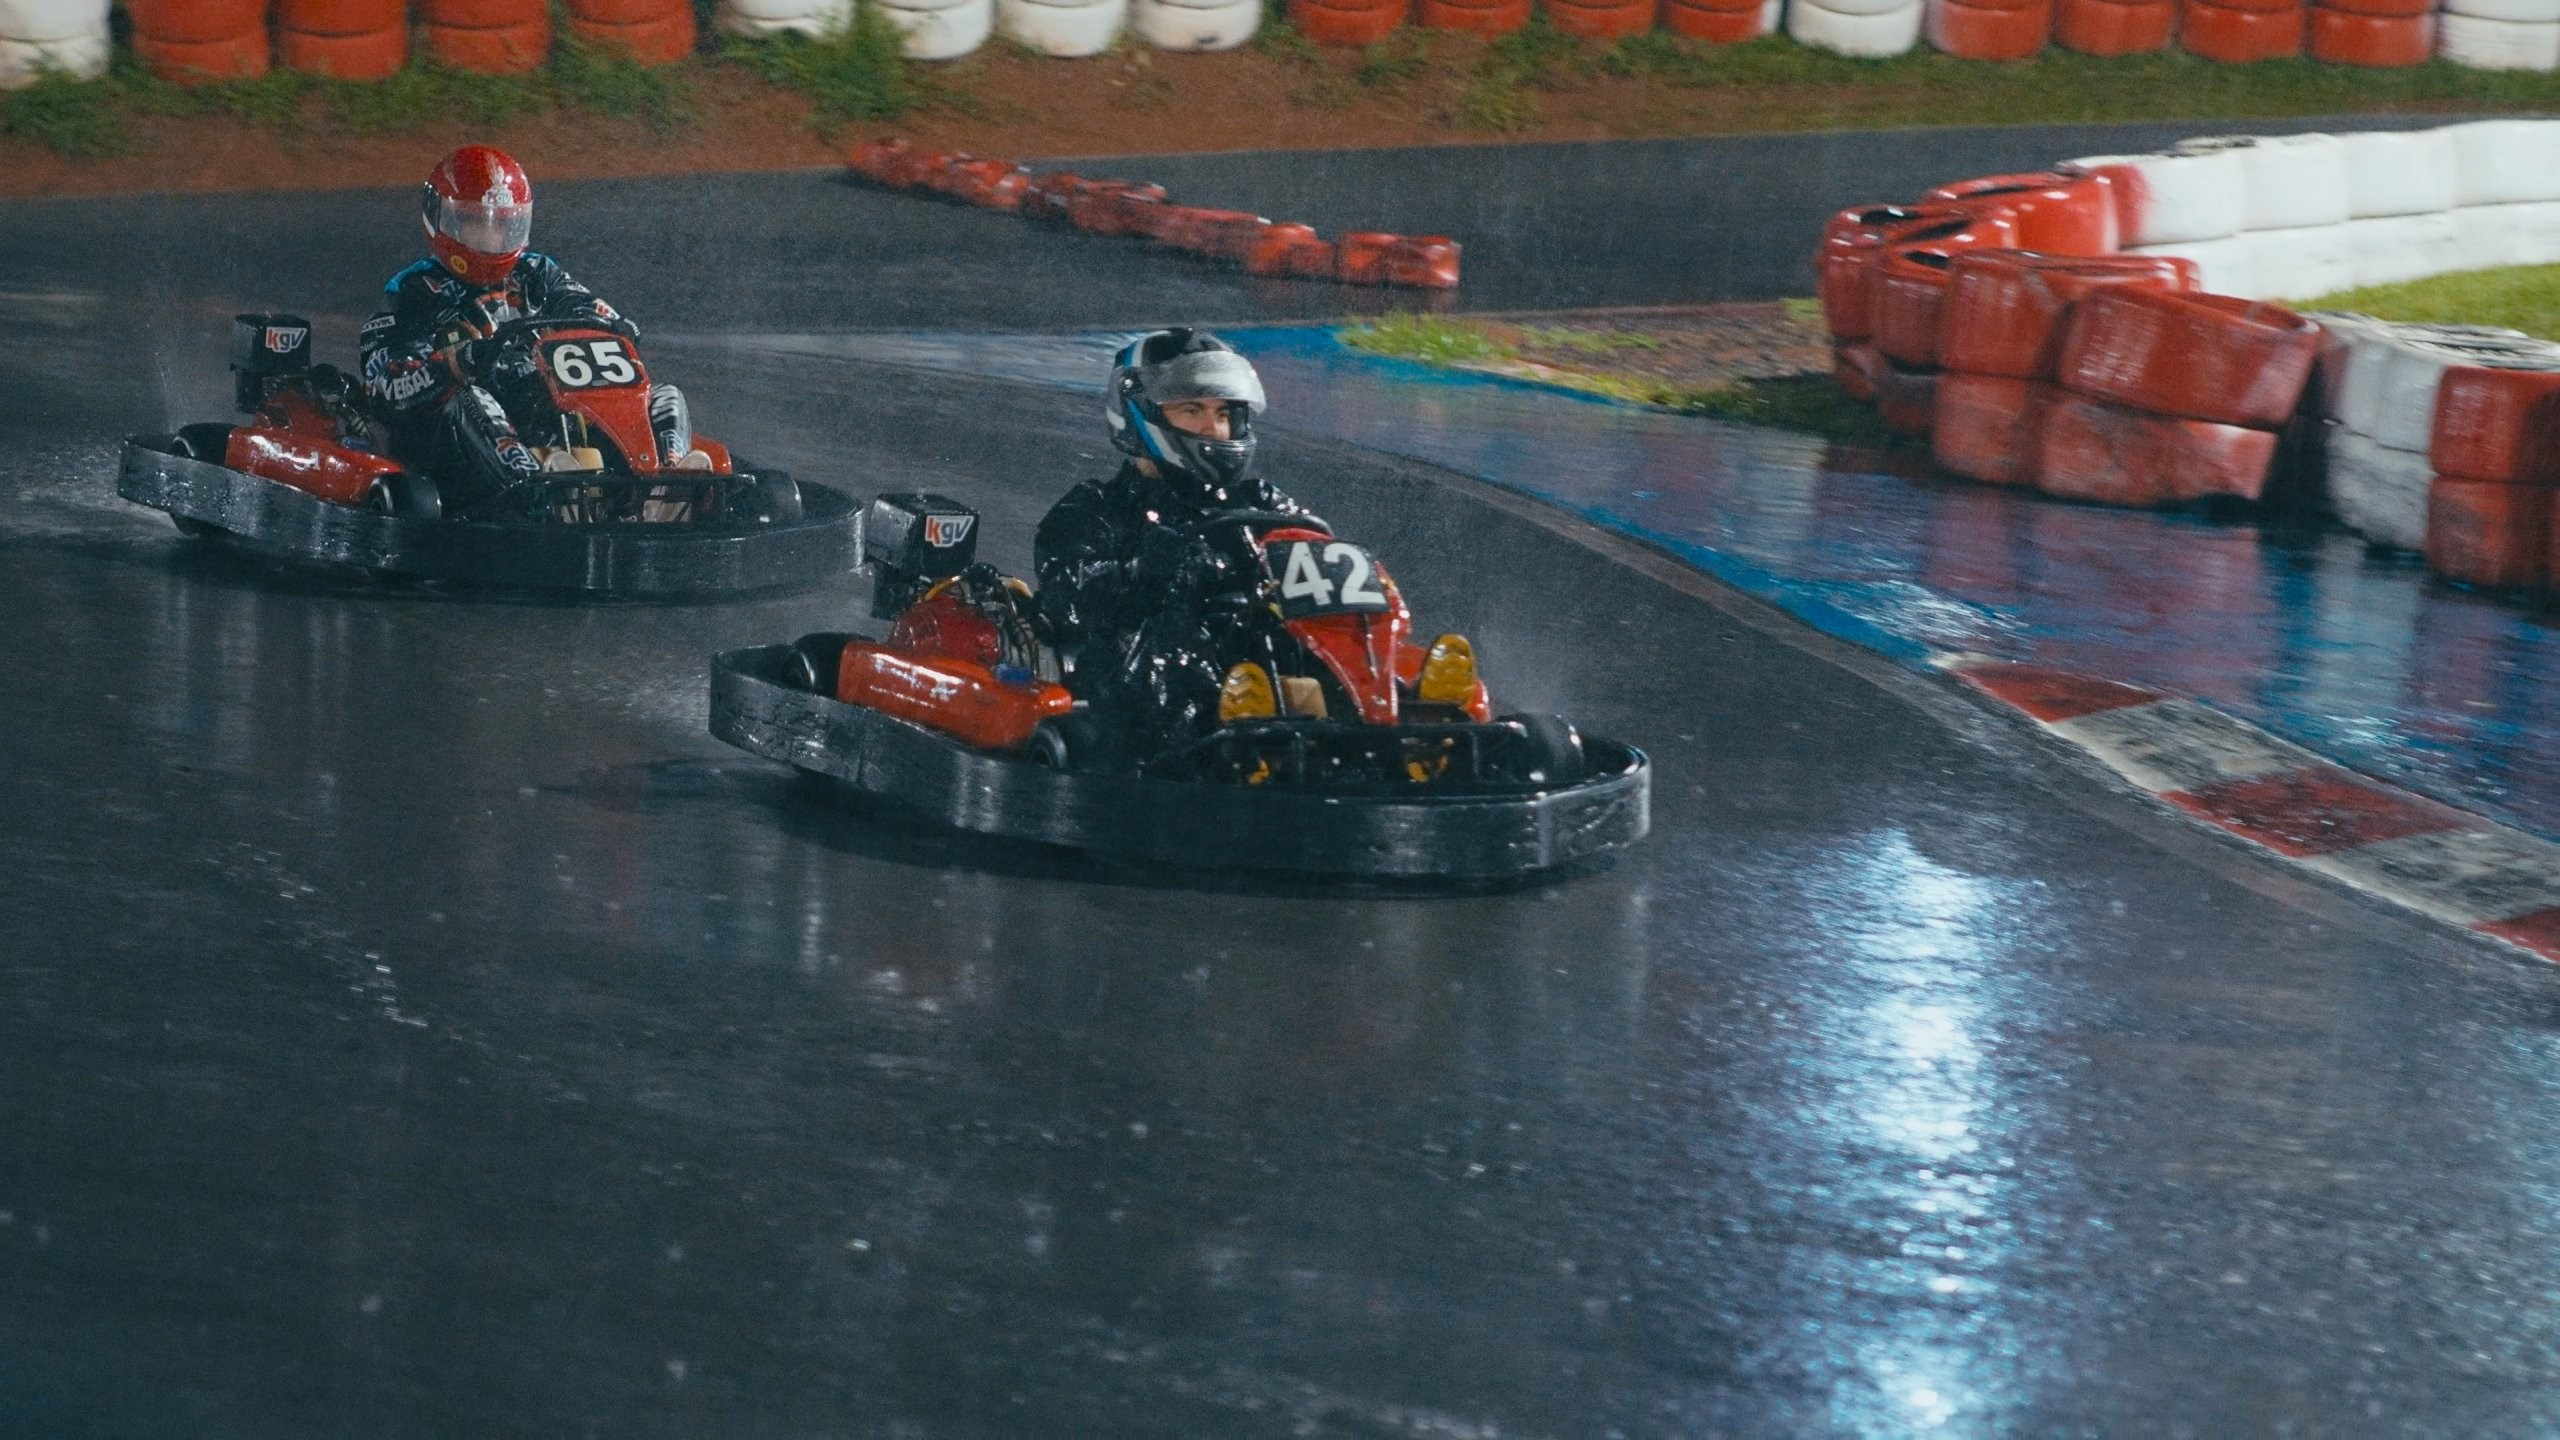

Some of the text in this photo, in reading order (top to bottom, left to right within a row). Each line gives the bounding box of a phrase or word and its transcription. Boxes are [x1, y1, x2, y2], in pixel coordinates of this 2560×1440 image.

[266, 327, 306, 352] kgv
[553, 341, 635, 386] 65
[926, 516, 973, 546] kgv
[1281, 541, 1387, 606] 42
